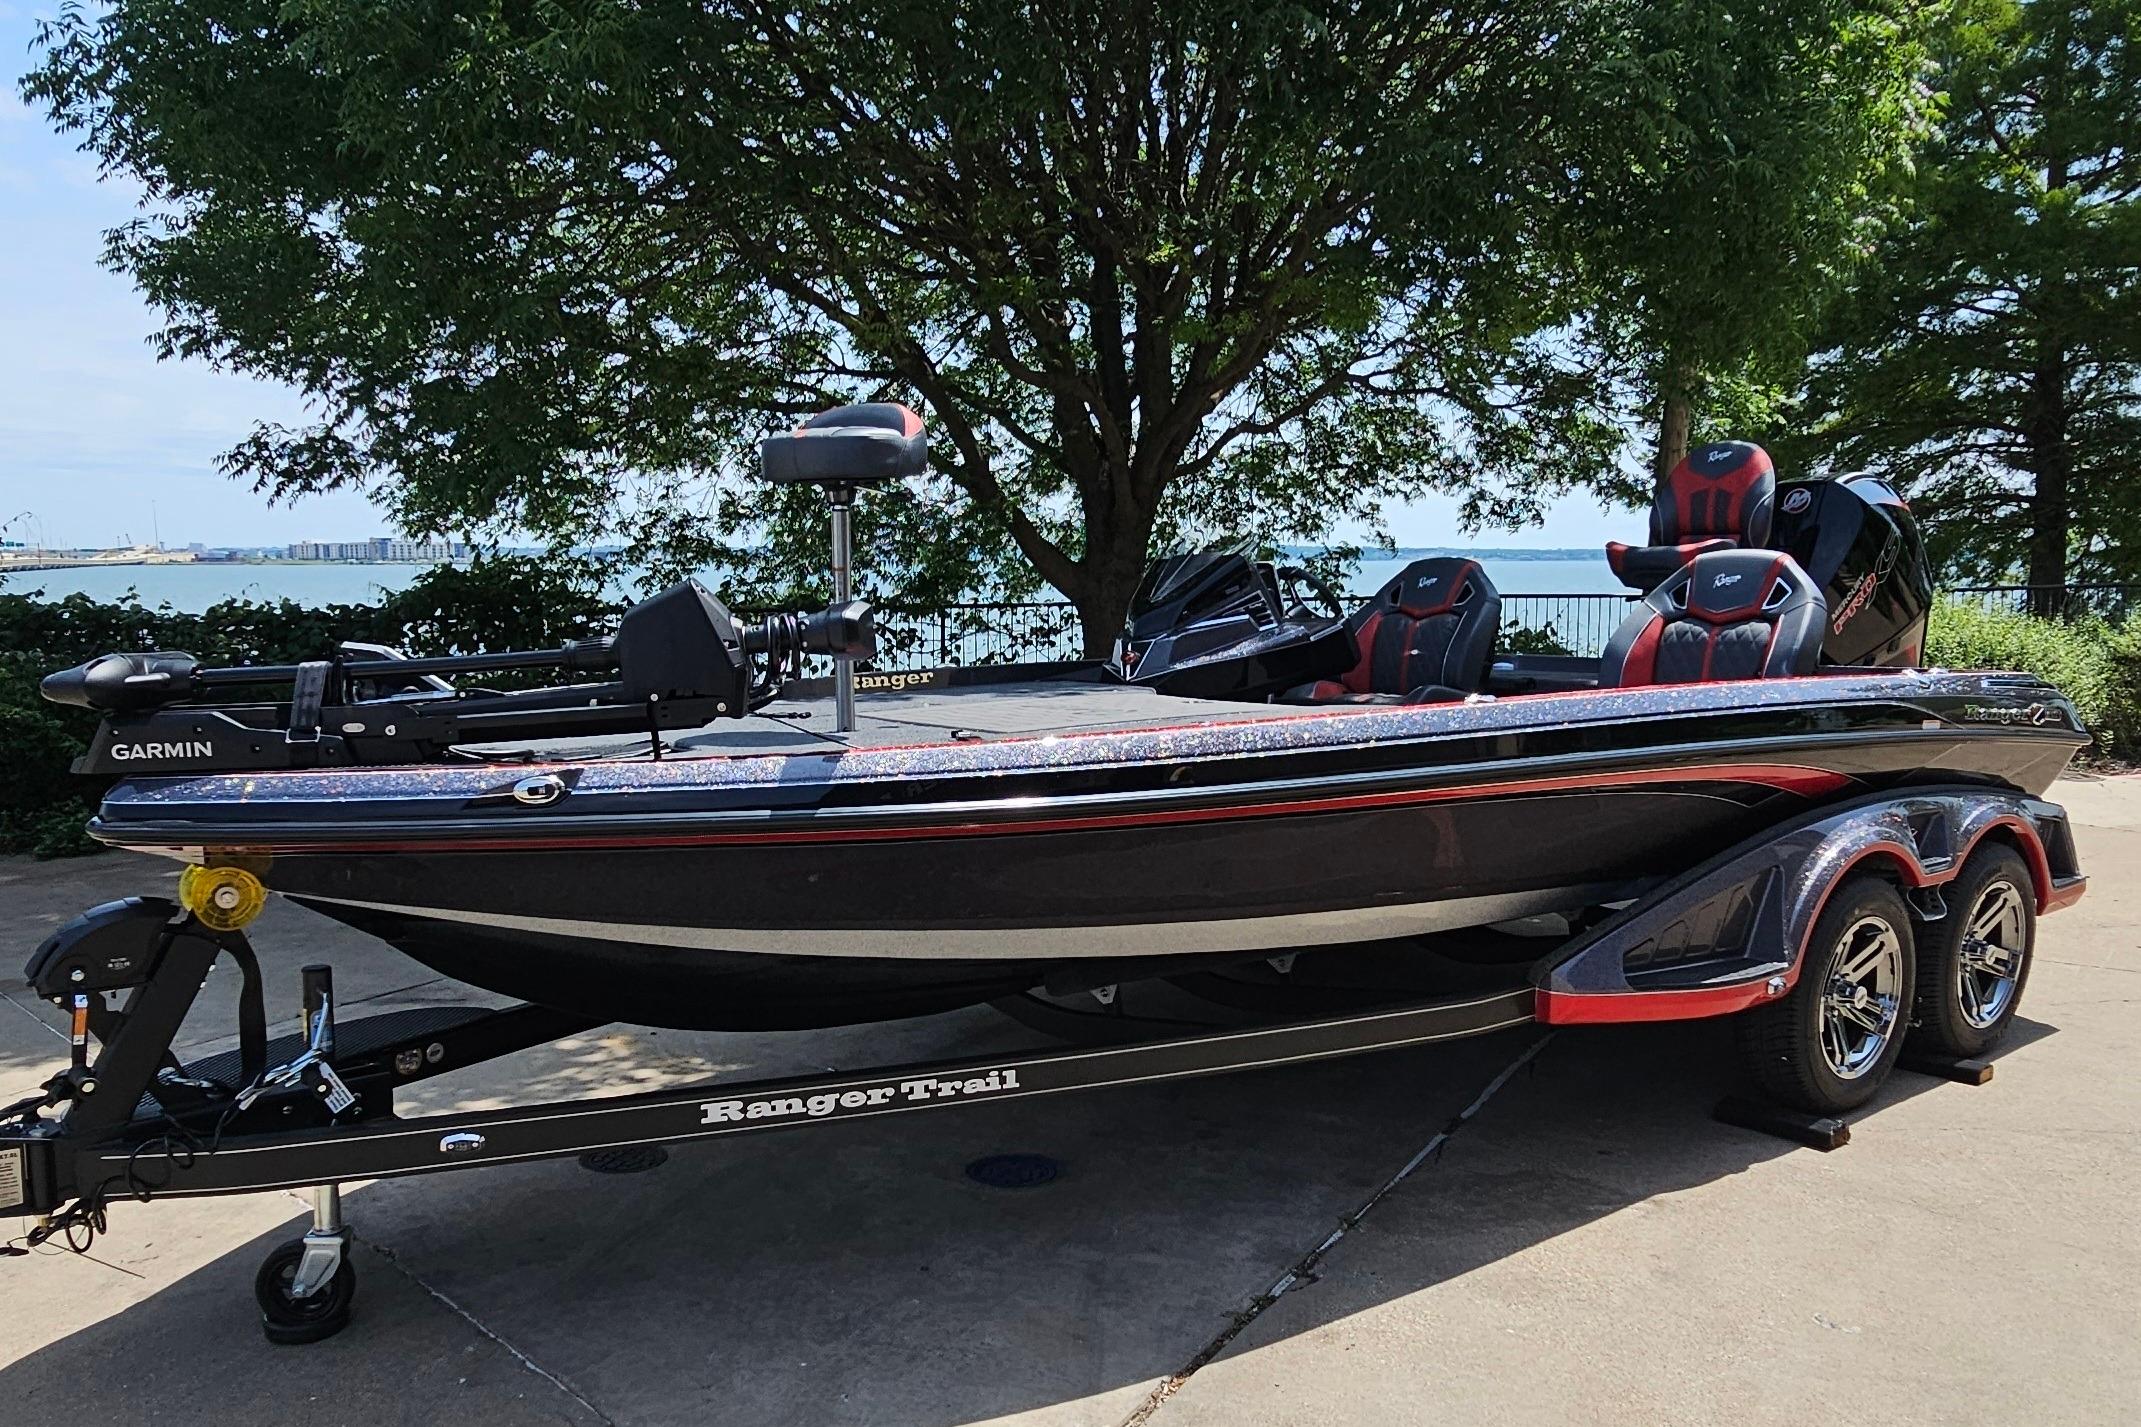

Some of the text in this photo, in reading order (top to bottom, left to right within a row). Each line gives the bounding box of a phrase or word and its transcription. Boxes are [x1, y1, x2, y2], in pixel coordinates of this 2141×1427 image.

[111, 741, 213, 760] GARMIN
[701, 1069, 1020, 1124] Ranger Trail
